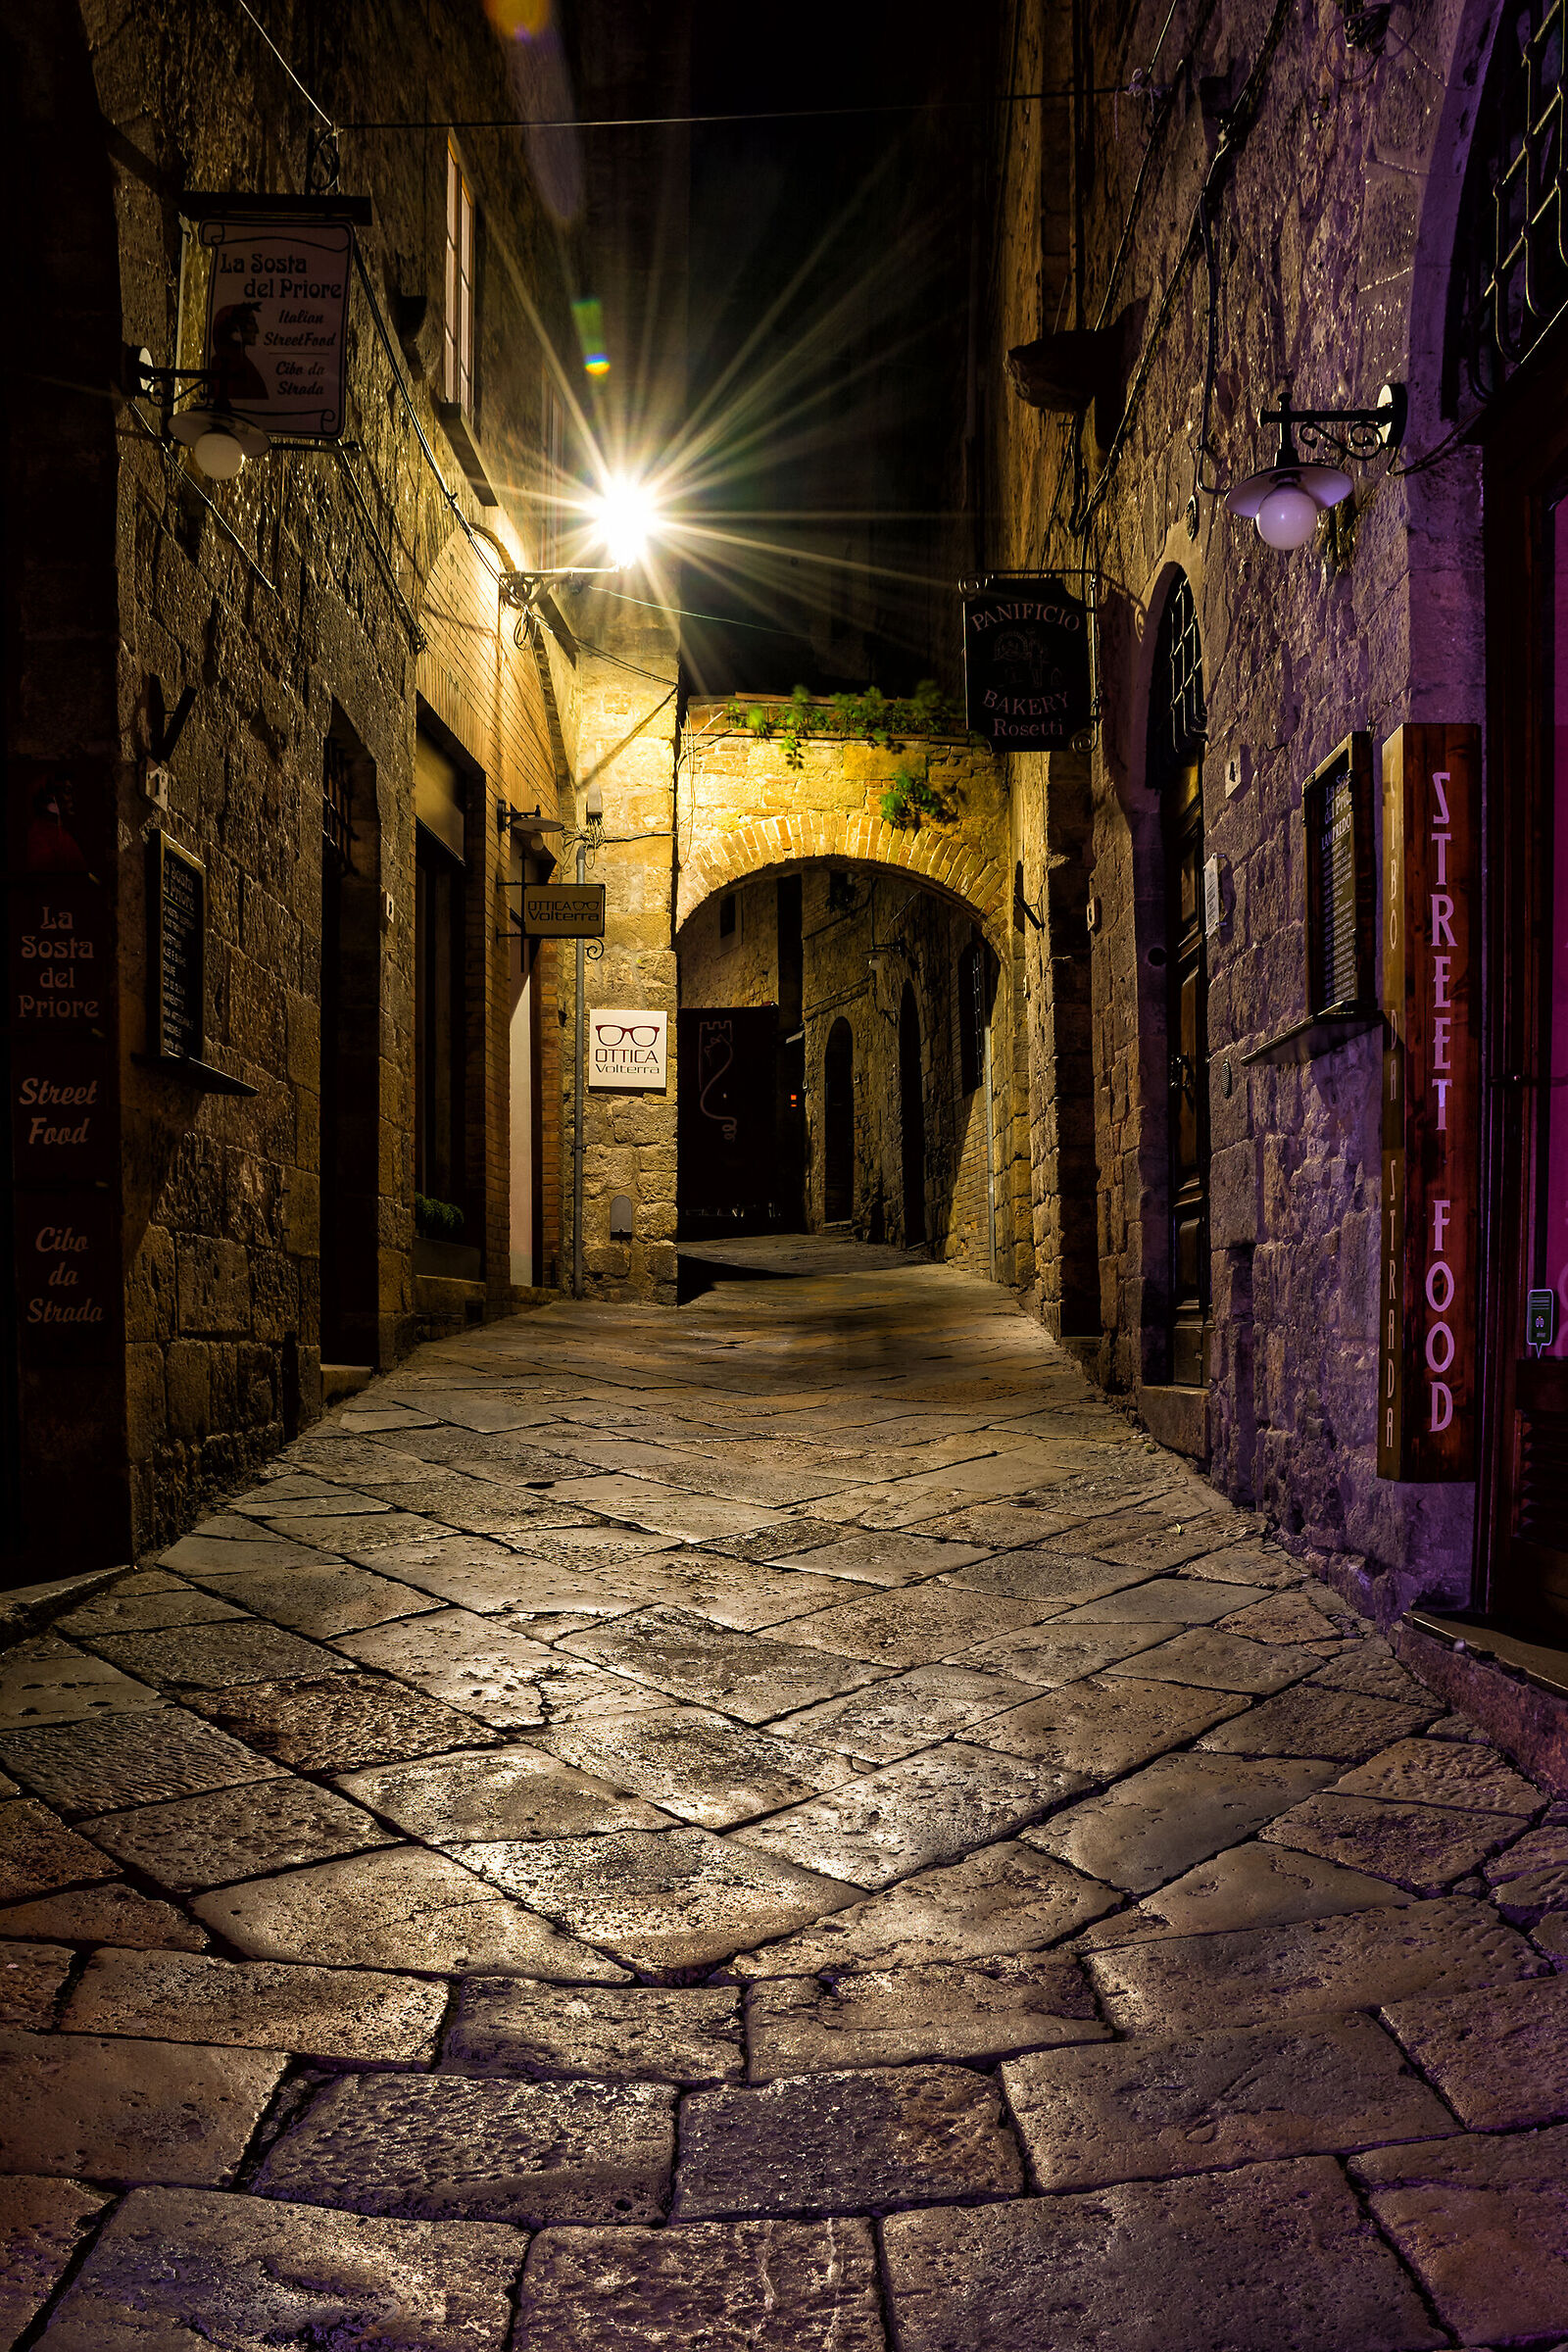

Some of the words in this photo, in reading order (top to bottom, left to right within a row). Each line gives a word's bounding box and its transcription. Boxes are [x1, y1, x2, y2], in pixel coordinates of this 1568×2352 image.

[220, 253, 244, 273] La
[251, 253, 307, 273] Sosta
[244, 278, 273, 298] del
[280, 278, 341, 298] Priore
[278, 310, 323, 323] Italian
[275, 361, 303, 375] Cibo
[308, 362, 324, 375] da
[277, 380, 323, 395] Strada
[970, 603, 1080, 632] PANIFICIO
[982, 689, 1070, 716] BAKERY
[992, 717, 1064, 737] Rosetti
[40, 906, 74, 930] La
[527, 901, 571, 911] OTTICA
[528, 910, 599, 921] Volterra
[21, 936, 94, 960] Sosta
[1431, 771, 1458, 1131] STREET
[39, 966, 75, 989] del
[18, 995, 99, 1019] Priore
[595, 1049, 659, 1064] OTTICA
[1390, 1009, 1396, 1102] DA
[595, 1063, 660, 1074] Volterra
[19, 1078, 97, 1105] Street
[28, 1117, 90, 1145] Food
[35, 1226, 89, 1253] Cibo
[48, 1262, 78, 1287] da
[26, 1298, 103, 1324] Strada
[1386, 1159, 1396, 1448] STRADA
[1425, 1200, 1455, 1433] FOOD
